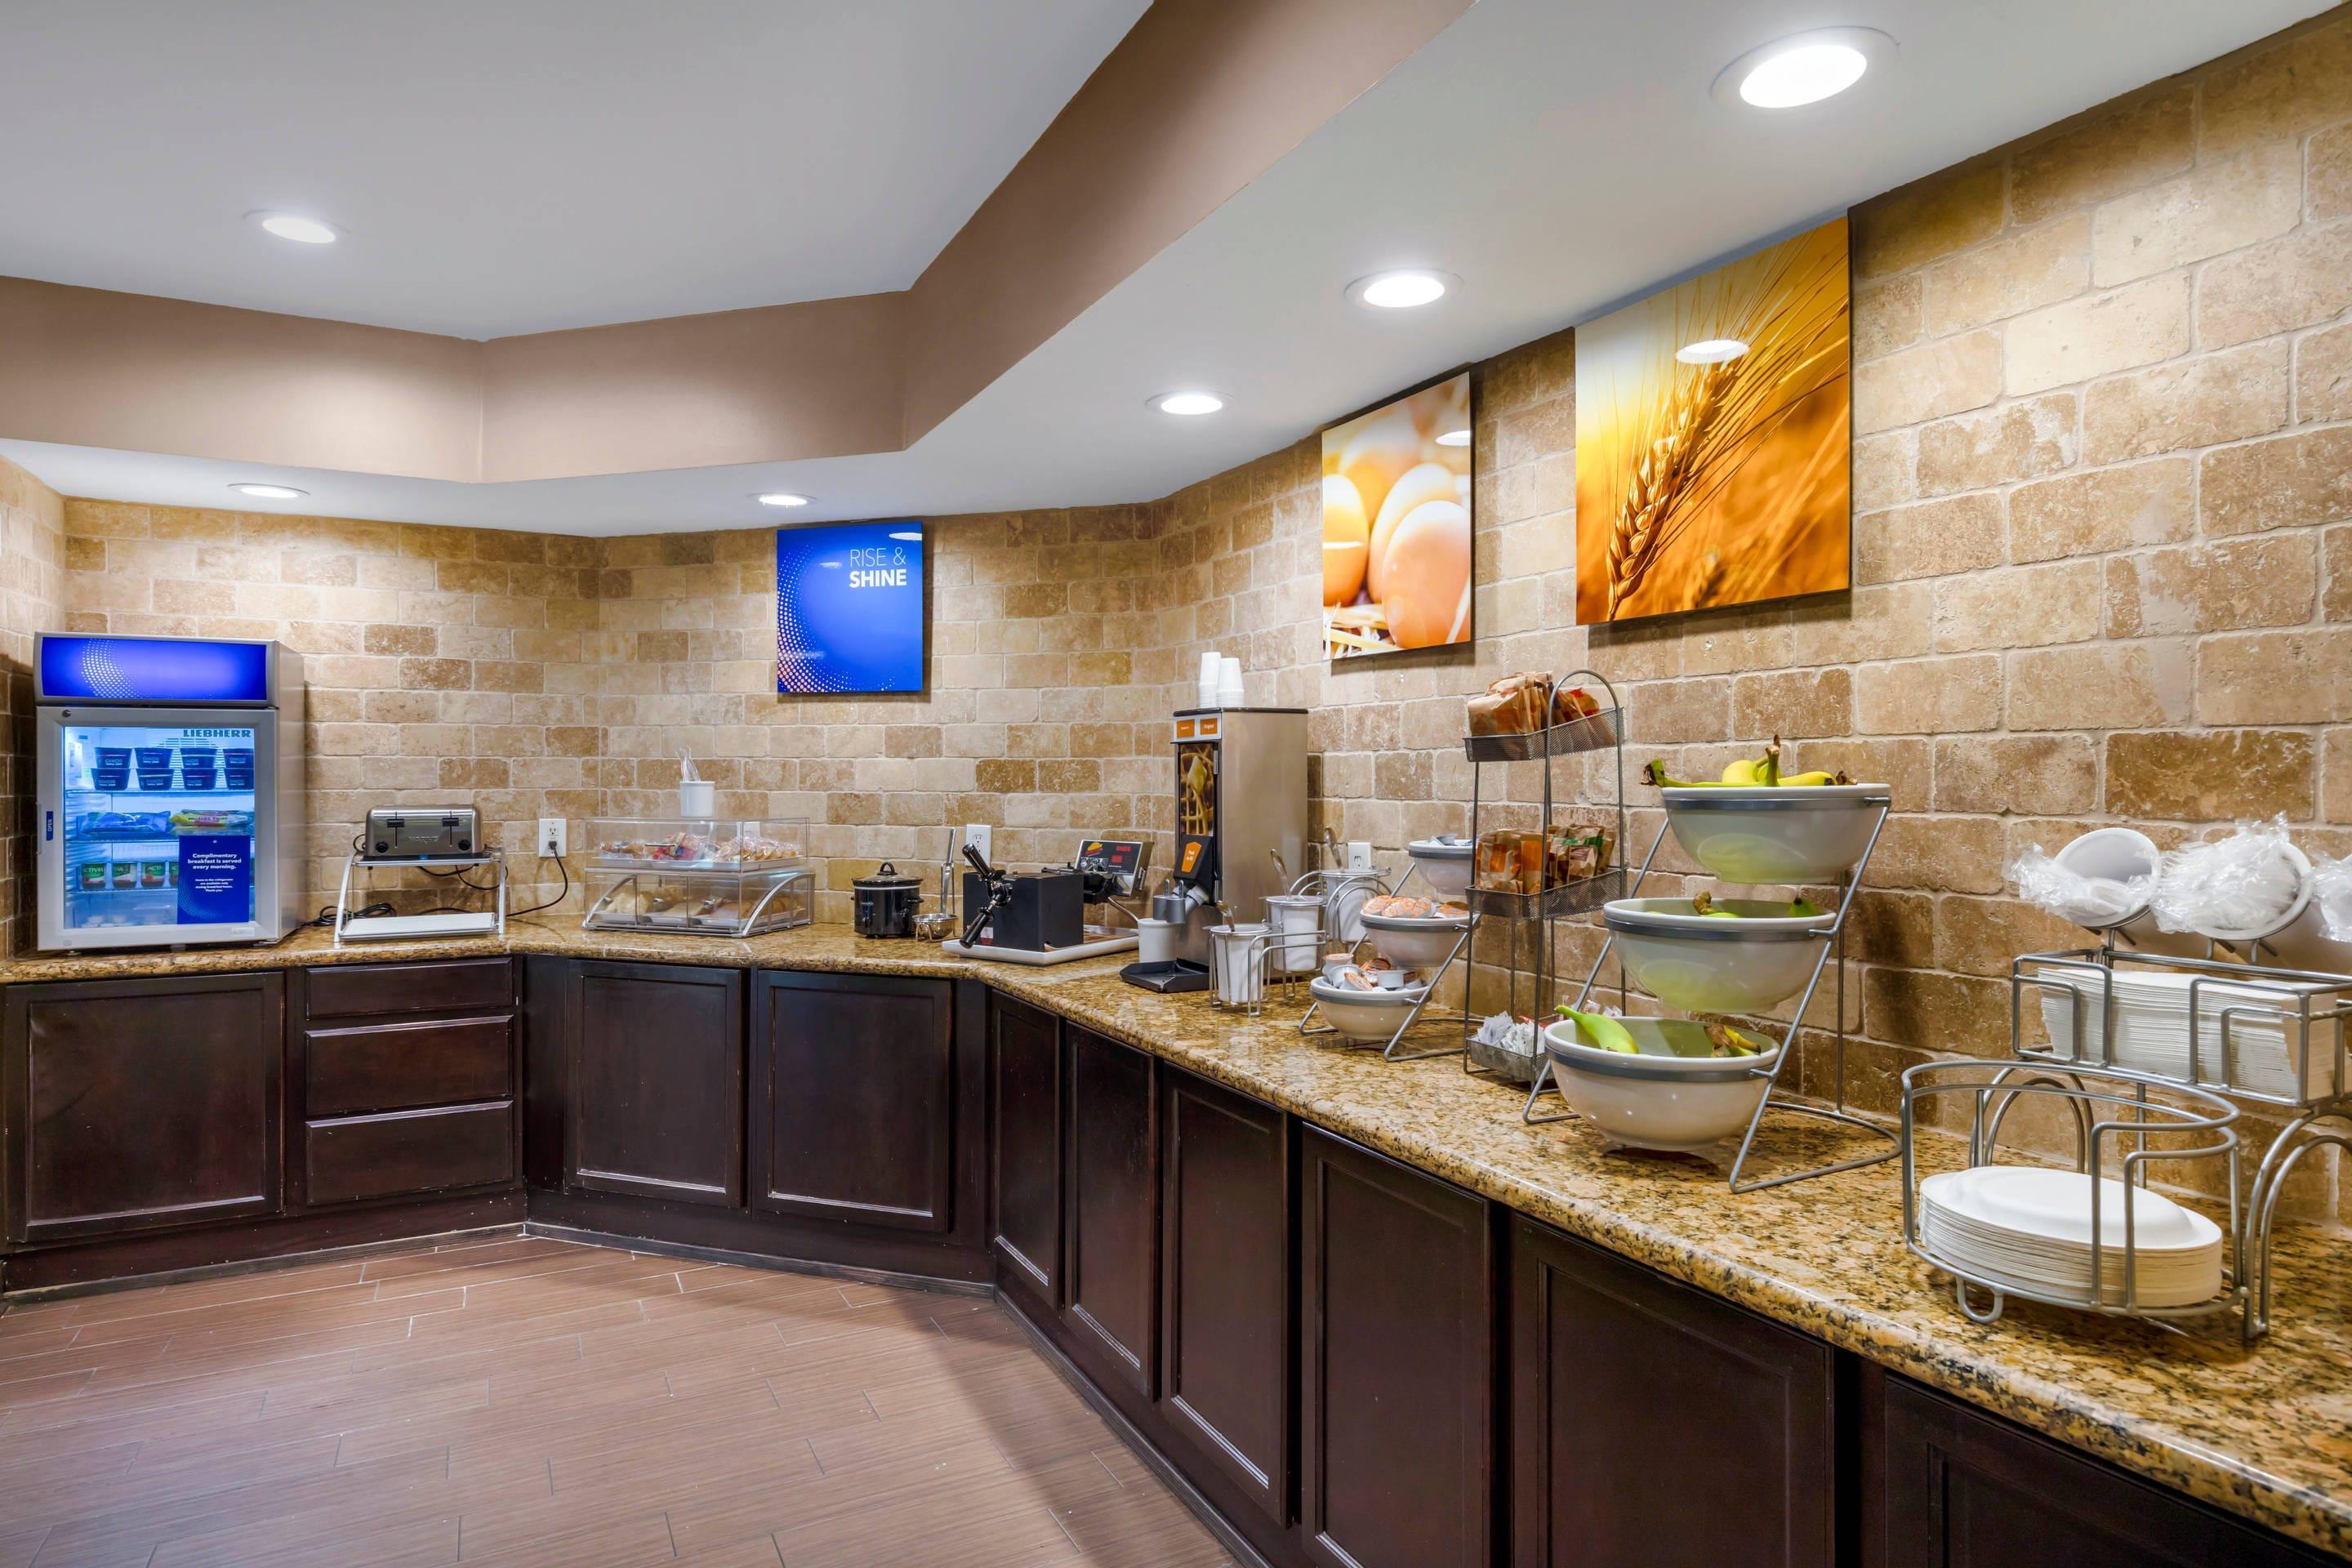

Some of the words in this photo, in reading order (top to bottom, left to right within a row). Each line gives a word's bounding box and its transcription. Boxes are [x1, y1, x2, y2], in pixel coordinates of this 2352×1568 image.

[850, 548, 888, 568] RISE
[893, 546, 906, 566] &
[849, 569, 906, 588] SHINE
[183, 729, 251, 738] LIEBHERR
